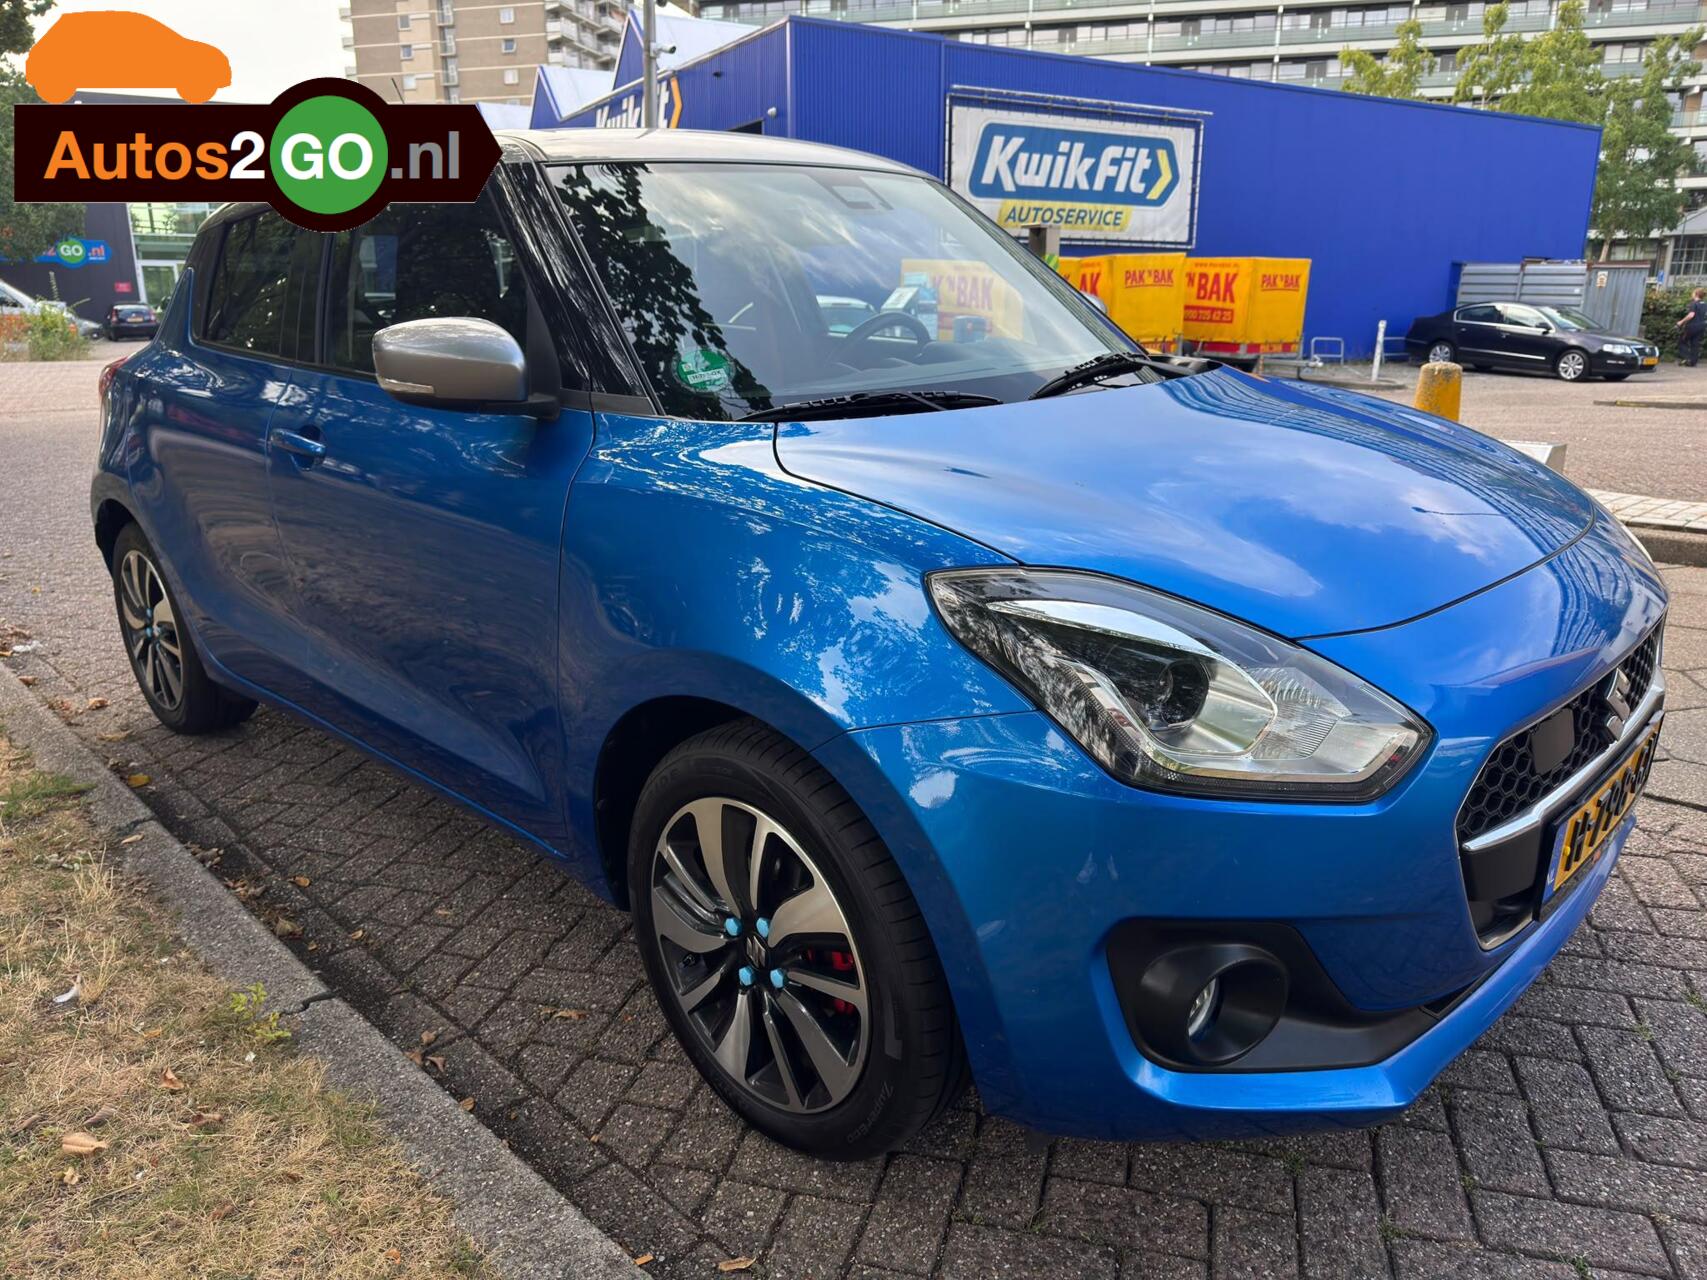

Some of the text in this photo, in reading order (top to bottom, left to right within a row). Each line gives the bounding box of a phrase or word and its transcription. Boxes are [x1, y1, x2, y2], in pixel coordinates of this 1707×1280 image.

[1004, 206, 1123, 227] AUTOSERVICE
[1125, 270, 1145, 286] PAK
[1153, 269, 1174, 284] BAK
[1196, 272, 1239, 304] BAK
[1261, 273, 1278, 288] PAK
[1284, 273, 1301, 288] BAK
[957, 275, 994, 310] BAK
